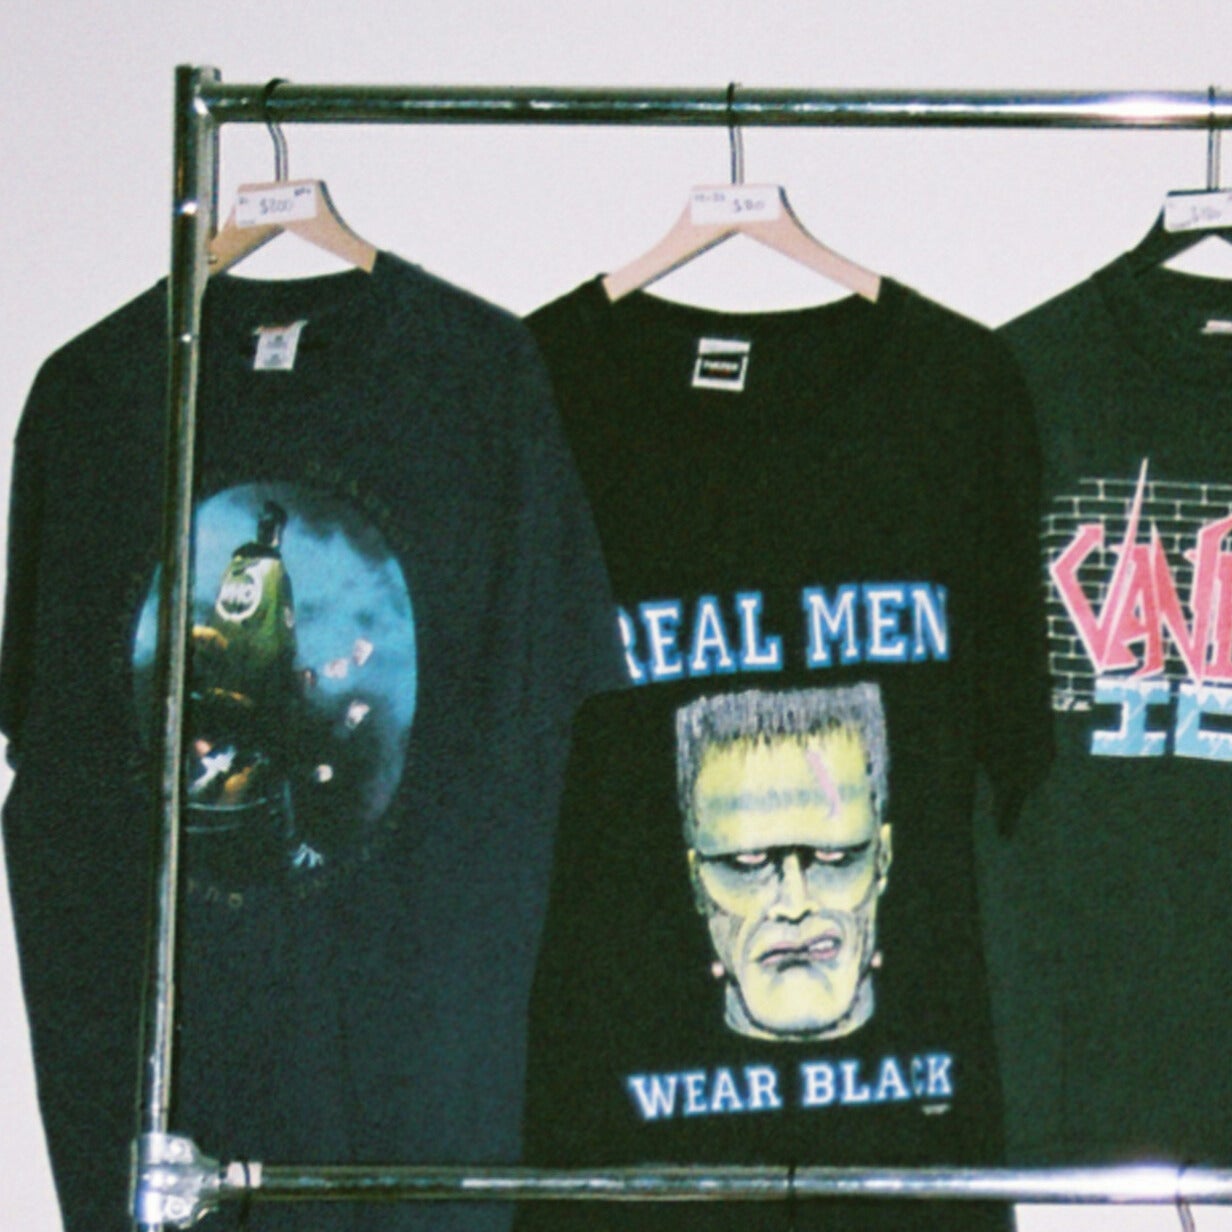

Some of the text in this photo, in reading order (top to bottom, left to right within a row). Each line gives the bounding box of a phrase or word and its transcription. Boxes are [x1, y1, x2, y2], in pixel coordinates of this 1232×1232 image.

[802, 580, 952, 670] MEN
[627, 1052, 956, 1122] WEAR BLACK
